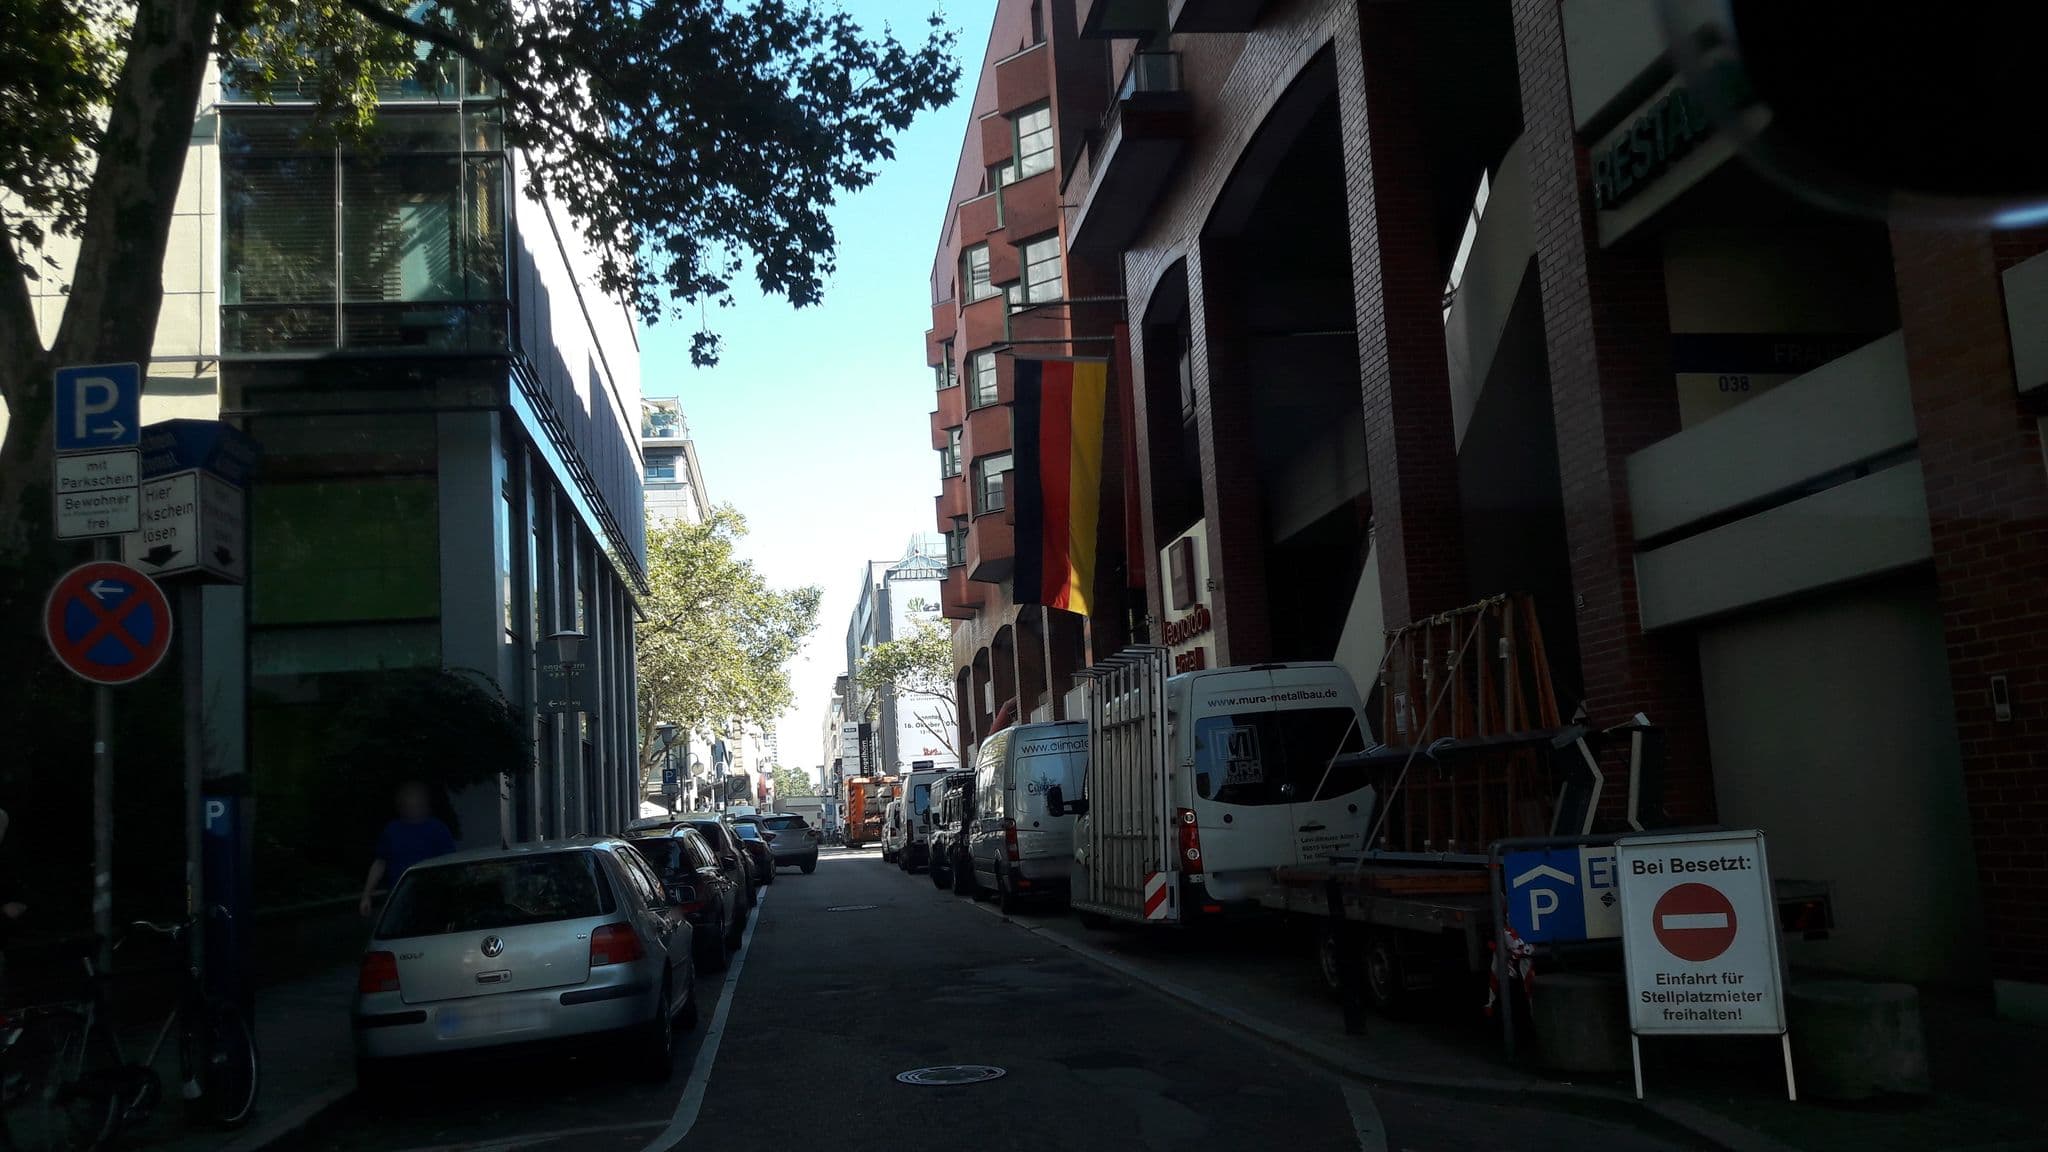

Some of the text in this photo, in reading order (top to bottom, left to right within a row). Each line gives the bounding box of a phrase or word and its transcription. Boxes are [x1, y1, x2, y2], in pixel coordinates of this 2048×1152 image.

[1719, 375, 1749, 392] 038
[74, 376, 119, 439] P
[86, 461, 107, 471] mit
[61, 474, 133, 488] Parkschein
[65, 495, 130, 510] Bewohner
[87, 517, 109, 529] frei
[1207, 689, 1338, 708] www.mura-metallbau.de
[205, 800, 225, 829] P
[1632, 855, 1752, 875] Bei Besetzt:
[1529, 888, 1559, 931] P
[1656, 972, 1744, 986] Einfahrt für
[1641, 990, 1763, 1006] Stellplatzmieter
[1663, 1008, 1742, 1021] freihalten!
